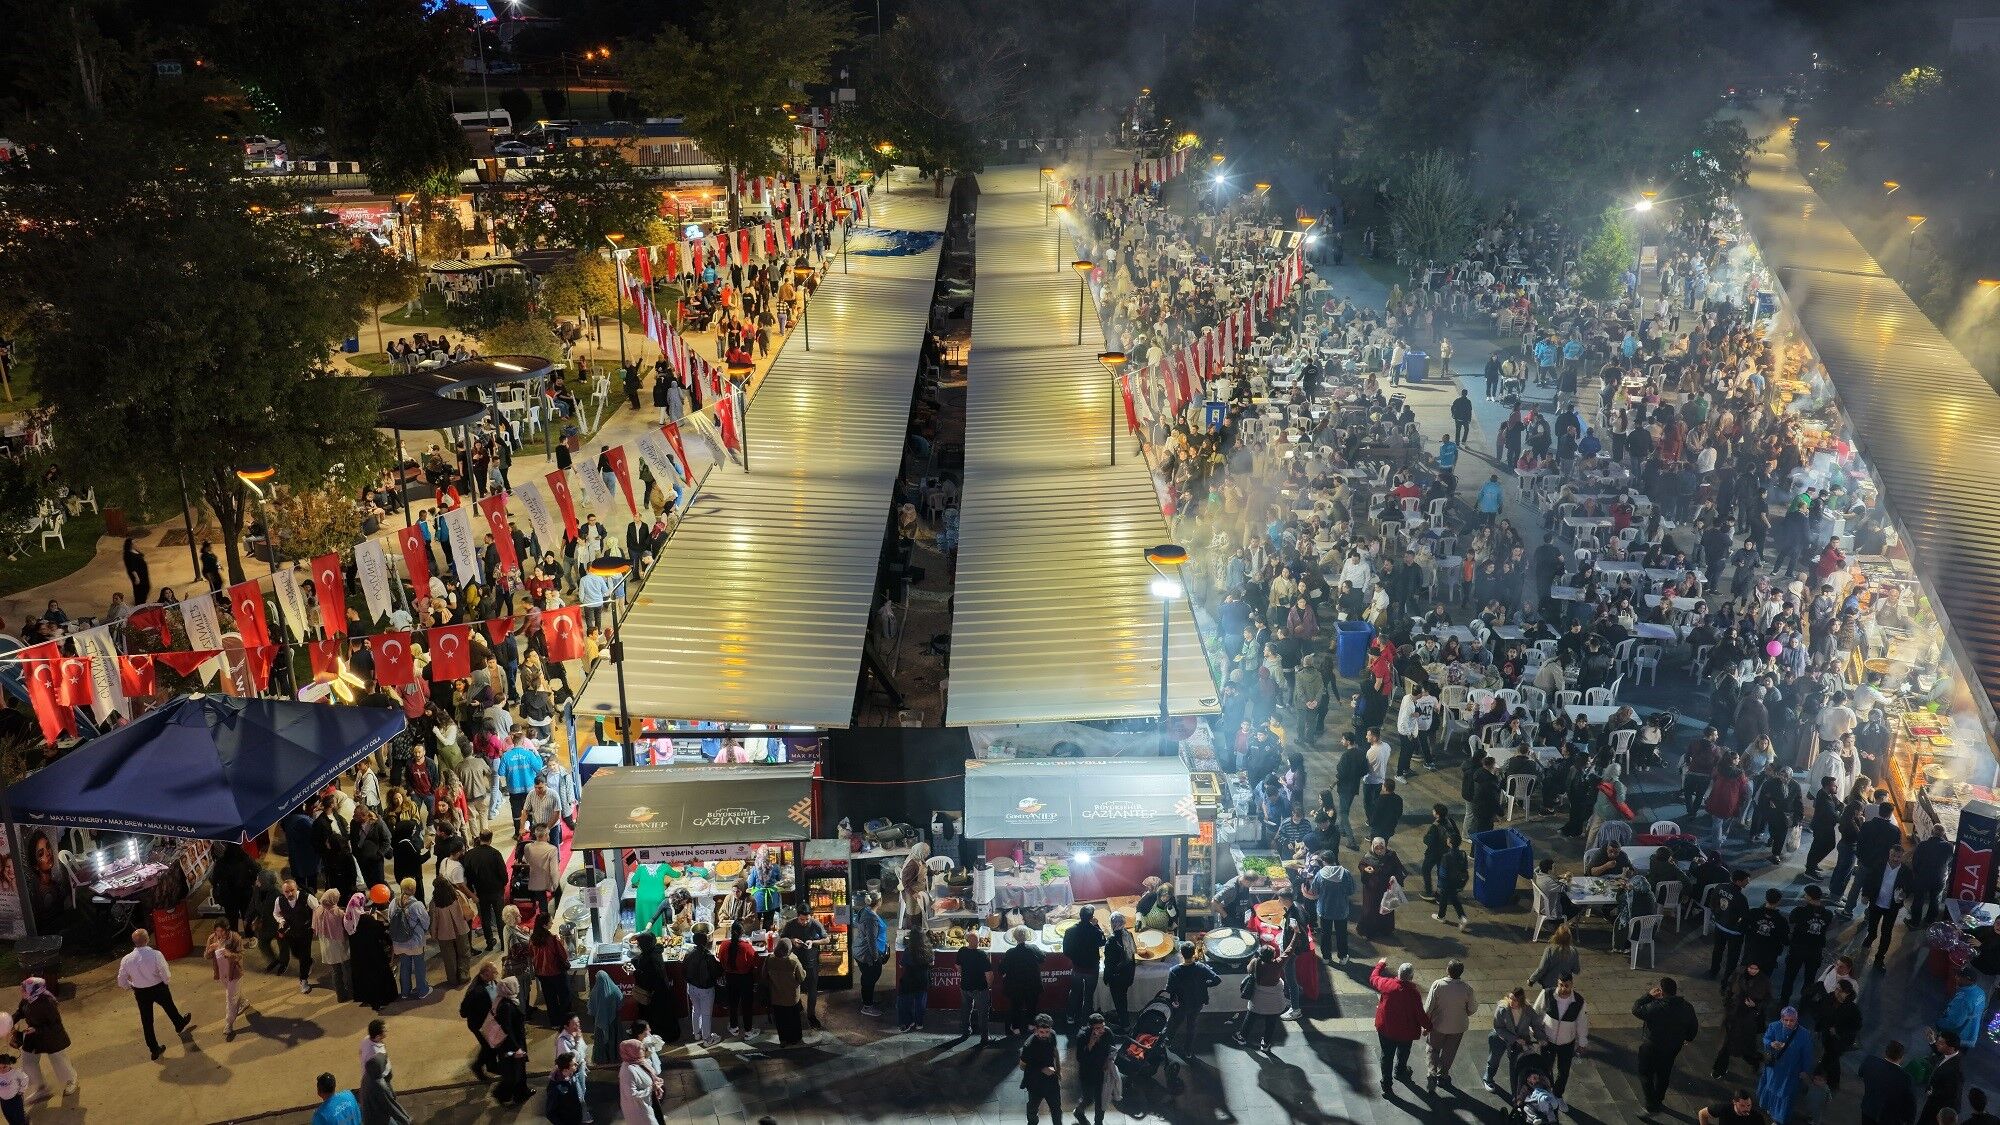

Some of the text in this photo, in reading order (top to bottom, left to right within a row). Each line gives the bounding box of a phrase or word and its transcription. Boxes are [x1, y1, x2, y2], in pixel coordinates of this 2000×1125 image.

[78, 816, 103, 824] ENERGY
[176, 825, 196, 834] COLA
[694, 848, 727, 856] SOFRASI
[1960, 864, 1981, 901] OLA
